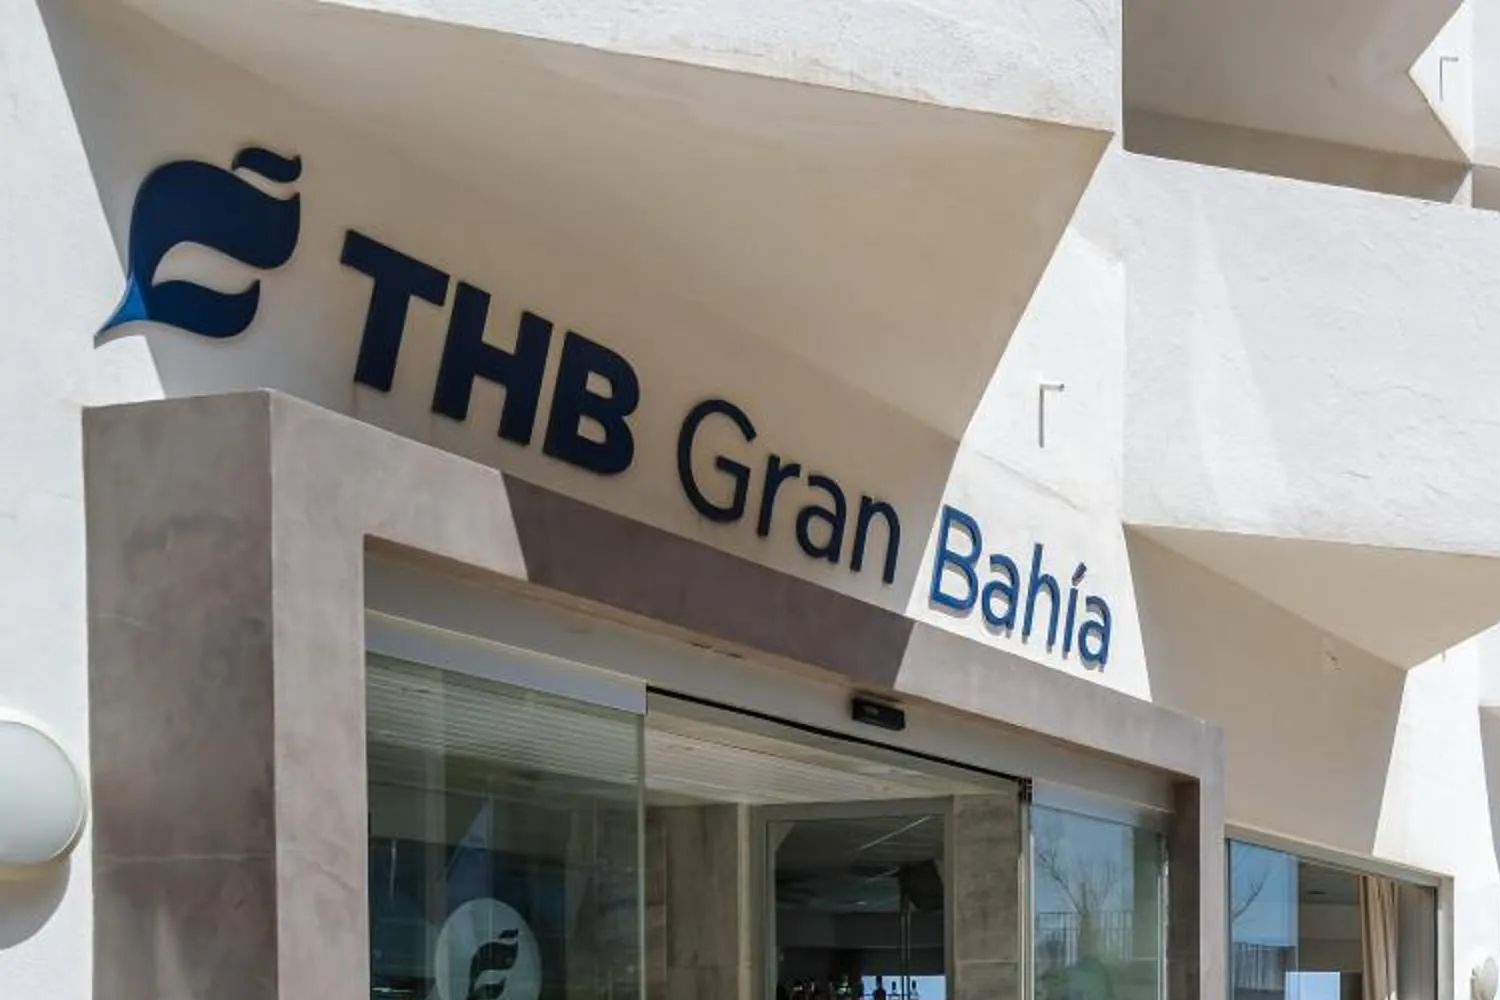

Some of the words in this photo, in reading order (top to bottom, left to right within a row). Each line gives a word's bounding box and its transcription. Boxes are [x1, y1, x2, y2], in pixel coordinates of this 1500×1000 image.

[340, 229, 640, 474] THB
[677, 399, 901, 584] Gran
[930, 504, 1112, 668] Bahía
